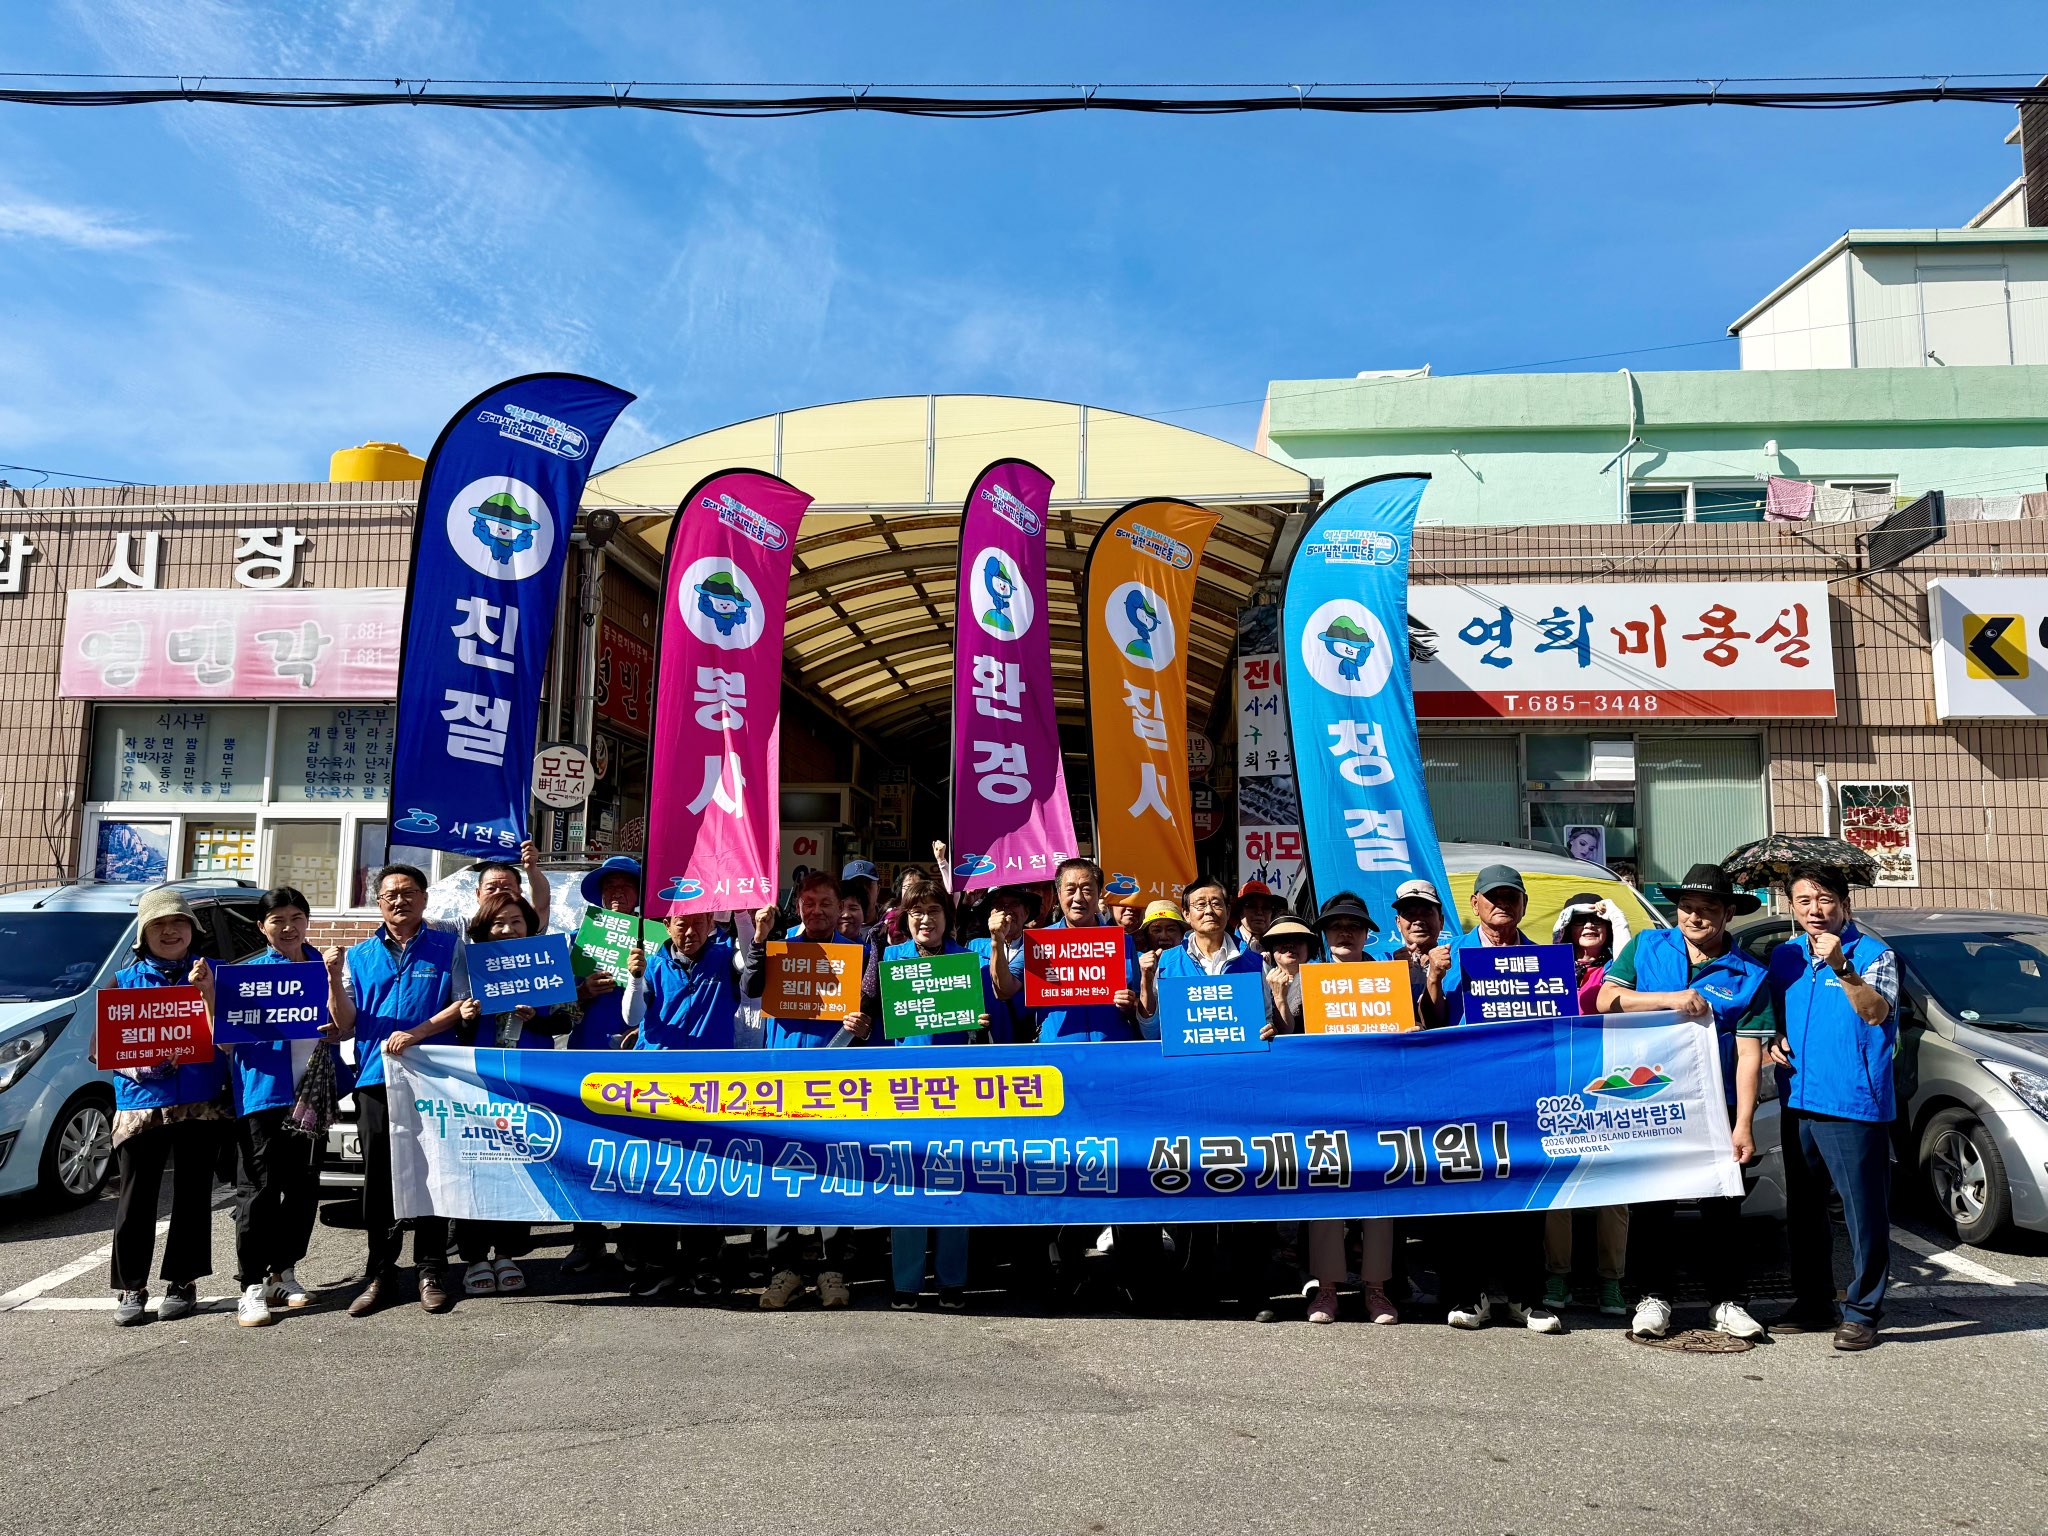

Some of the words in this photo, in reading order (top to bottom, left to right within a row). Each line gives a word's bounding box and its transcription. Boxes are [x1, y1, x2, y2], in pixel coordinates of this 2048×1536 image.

[440, 596, 520, 767] 친절
[1503, 695, 1658, 711] T.685-3448
[157, 713, 207, 730] 식사부
[338, 709, 389, 726] 안주부
[308, 727, 357, 739] 계란탕
[971, 654, 1032, 804] 환경
[125, 737, 174, 749] 자장면
[685, 665, 747, 819] 봉사
[306, 757, 355, 769] 탕수육小
[541, 757, 585, 779] 모모
[305, 771, 355, 784] 탕수육中
[120, 781, 171, 793] 간짜장
[182, 781, 232, 795] 볶음밥
[304, 786, 354, 799] 탕수육大
[1328, 718, 1412, 874] 청결
[449, 822, 516, 849] 시전동
[1245, 831, 1303, 861] 하모
[1005, 851, 1069, 871] 시전동
[713, 876, 773, 896] 시전동
[592, 913, 631, 933] 청렴은
[581, 943, 620, 965] 청탁은
[1032, 944, 1056, 960] 허위
[1059, 941, 1117, 959] 시간외근무
[485, 954, 532, 972] 청렴한
[535, 950, 555, 966] 나,
[782, 957, 811, 975] 허위
[815, 958, 846, 976] 출장
[1494, 956, 1540, 974] 부패를
[890, 962, 933, 981] 청렴은
[1044, 966, 1074, 982] 절대
[1079, 965, 1106, 981] NO!
[238, 981, 273, 998] 청렴
[277, 980, 305, 997] UP,
[484, 978, 531, 998] 청렴한
[533, 974, 564, 991] 여수
[782, 981, 811, 997] 절대
[815, 981, 842, 998] NO!
[911, 975, 972, 994] 무한반복!
[1075, 987, 1090, 997] 가산
[1186, 984, 1234, 1002] 청렴은
[1320, 978, 1353, 995] 허위
[1358, 977, 1391, 994] 출장
[1470, 978, 1530, 997] 예방하는
[1534, 977, 1570, 996] 소금,
[107, 1004, 135, 1021] 허위
[138, 1000, 205, 1020] 시간외근무
[226, 1009, 260, 1026] 부패
[265, 1006, 318, 1024] ZERO!
[812, 1001, 828, 1012] 가산
[893, 998, 936, 1017] 청탁은
[1187, 1006, 1239, 1024] 나부터,
[1325, 1001, 1357, 1018] 절대
[1361, 1000, 1391, 1016] NO!
[1481, 1000, 1562, 1018] 청렴입니다.
[914, 1010, 976, 1030] 무한근절!
[121, 1026, 156, 1044] 절대
[160, 1025, 192, 1041] NO!
[1183, 1026, 1246, 1045] 지금부터
[155, 1047, 173, 1058] 가산
[601, 1080, 671, 1113] 여수
[687, 1079, 784, 1115] 제2의
[802, 1078, 874, 1112] 도약
[888, 1075, 960, 1112] 발판
[973, 1073, 1045, 1109] 마련
[1538, 1095, 1582, 1114] 2026
[415, 1099, 525, 1138] 여수르네상스
[1539, 1102, 1687, 1134] 여수세계섬박람회
[1544, 1137, 1565, 1147] 2026
[1566, 1134, 1597, 1146] WORLD
[1598, 1131, 1631, 1142] ISLAND
[1632, 1126, 1684, 1139] EXHIBITION
[1546, 1146, 1577, 1156] YEOSU
[1578, 1144, 1611, 1154] KOREA
[587, 1136, 1119, 1197] 2026여수세계섬박람회
[1148, 1130, 1352, 1194] 성공개최
